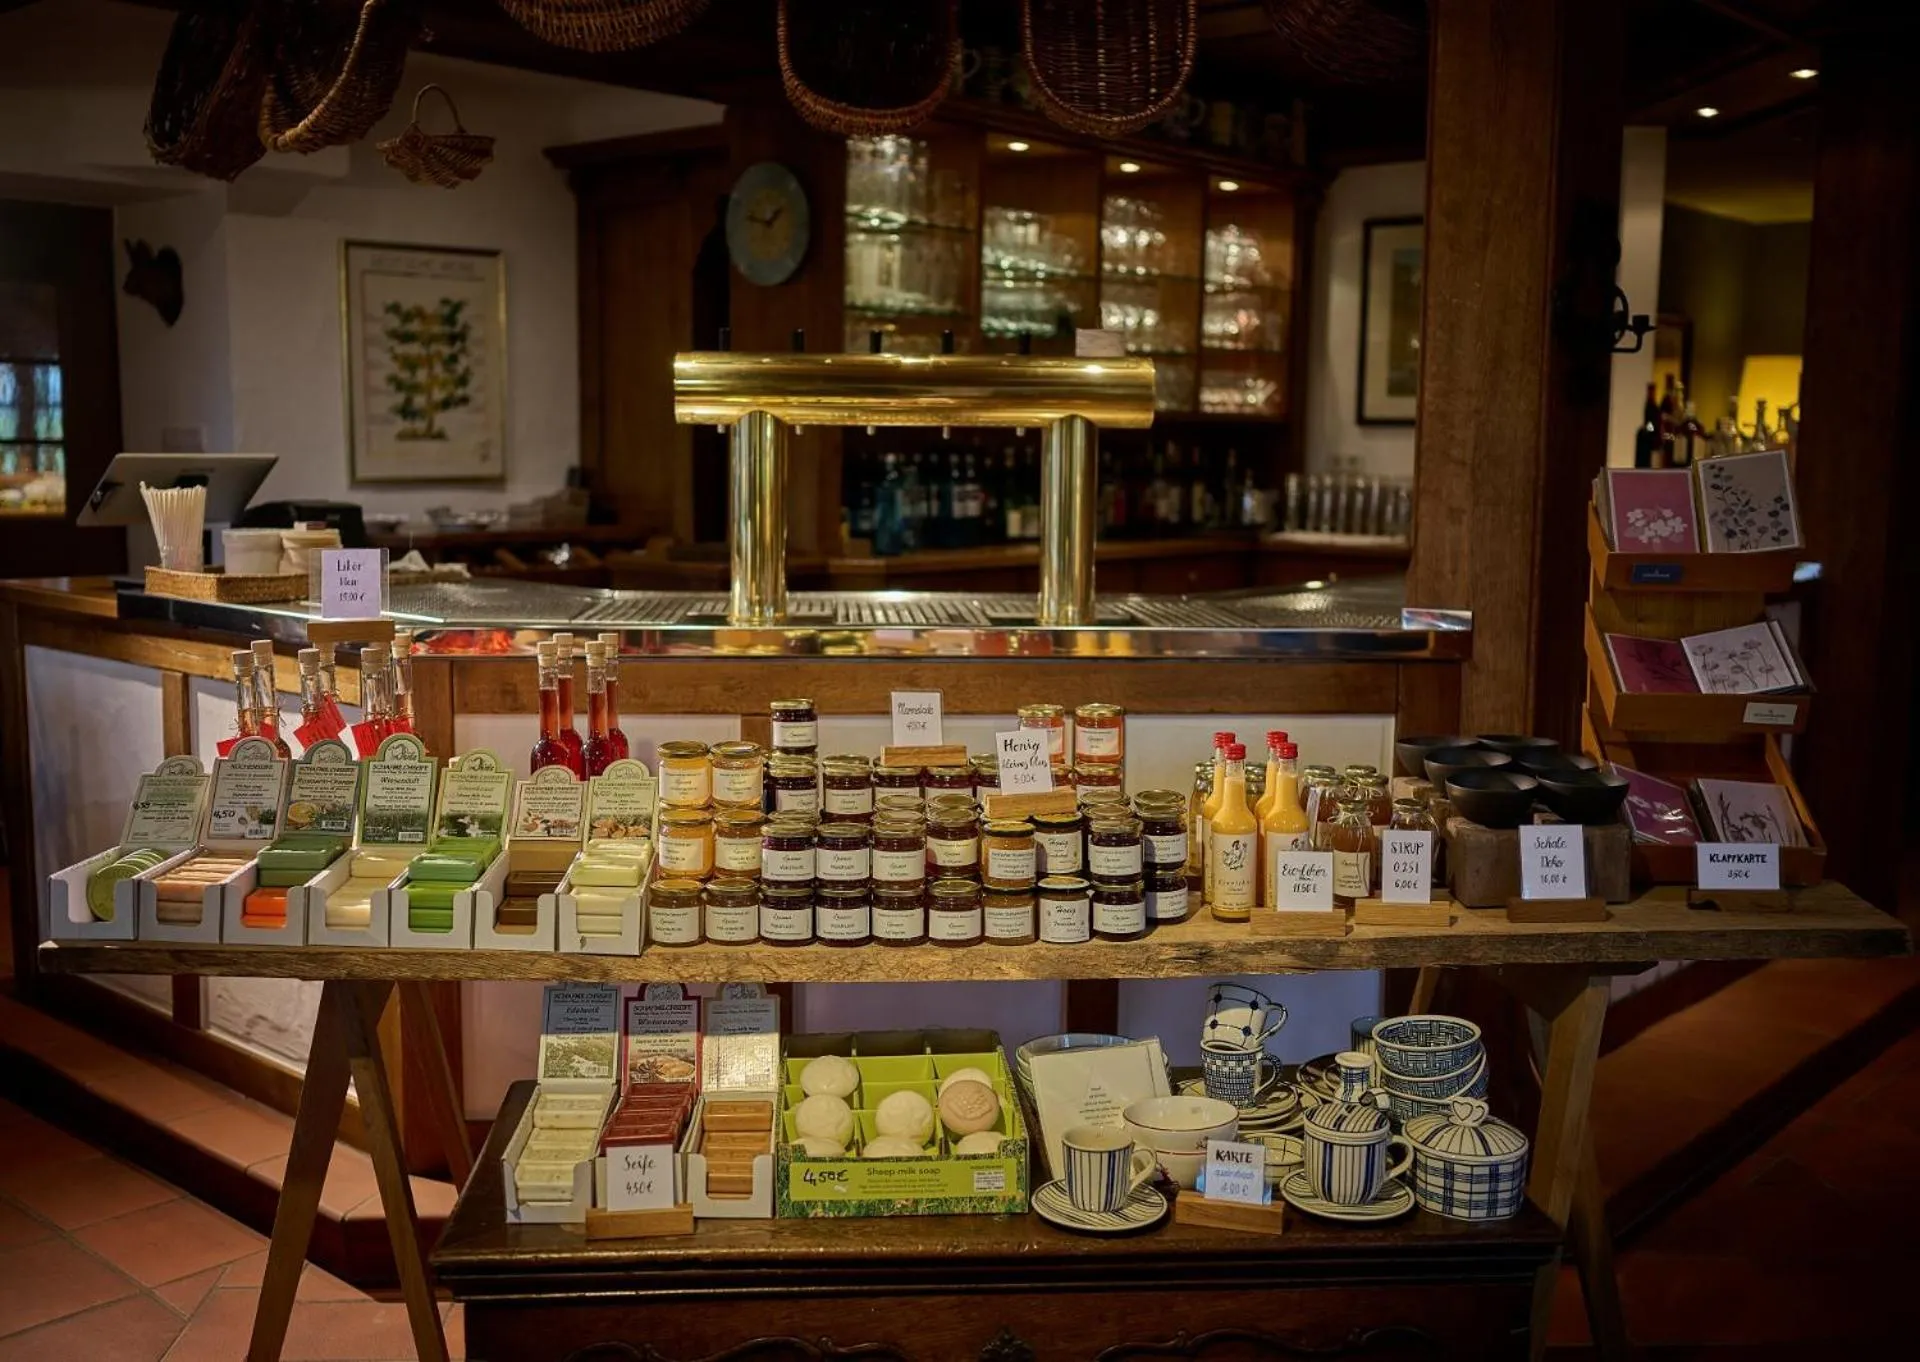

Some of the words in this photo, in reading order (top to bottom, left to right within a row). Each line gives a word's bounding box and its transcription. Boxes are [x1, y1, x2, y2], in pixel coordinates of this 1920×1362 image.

[1004, 738, 1040, 756] Honig
[1391, 842, 1424, 855] SIRUP
[1534, 836, 1568, 850] Schale
[1709, 853, 1769, 864] KLAPPKARTE
[1215, 1149, 1253, 1164] KARTE
[624, 1154, 656, 1175] Seife
[918, 1166, 941, 1177] soap
